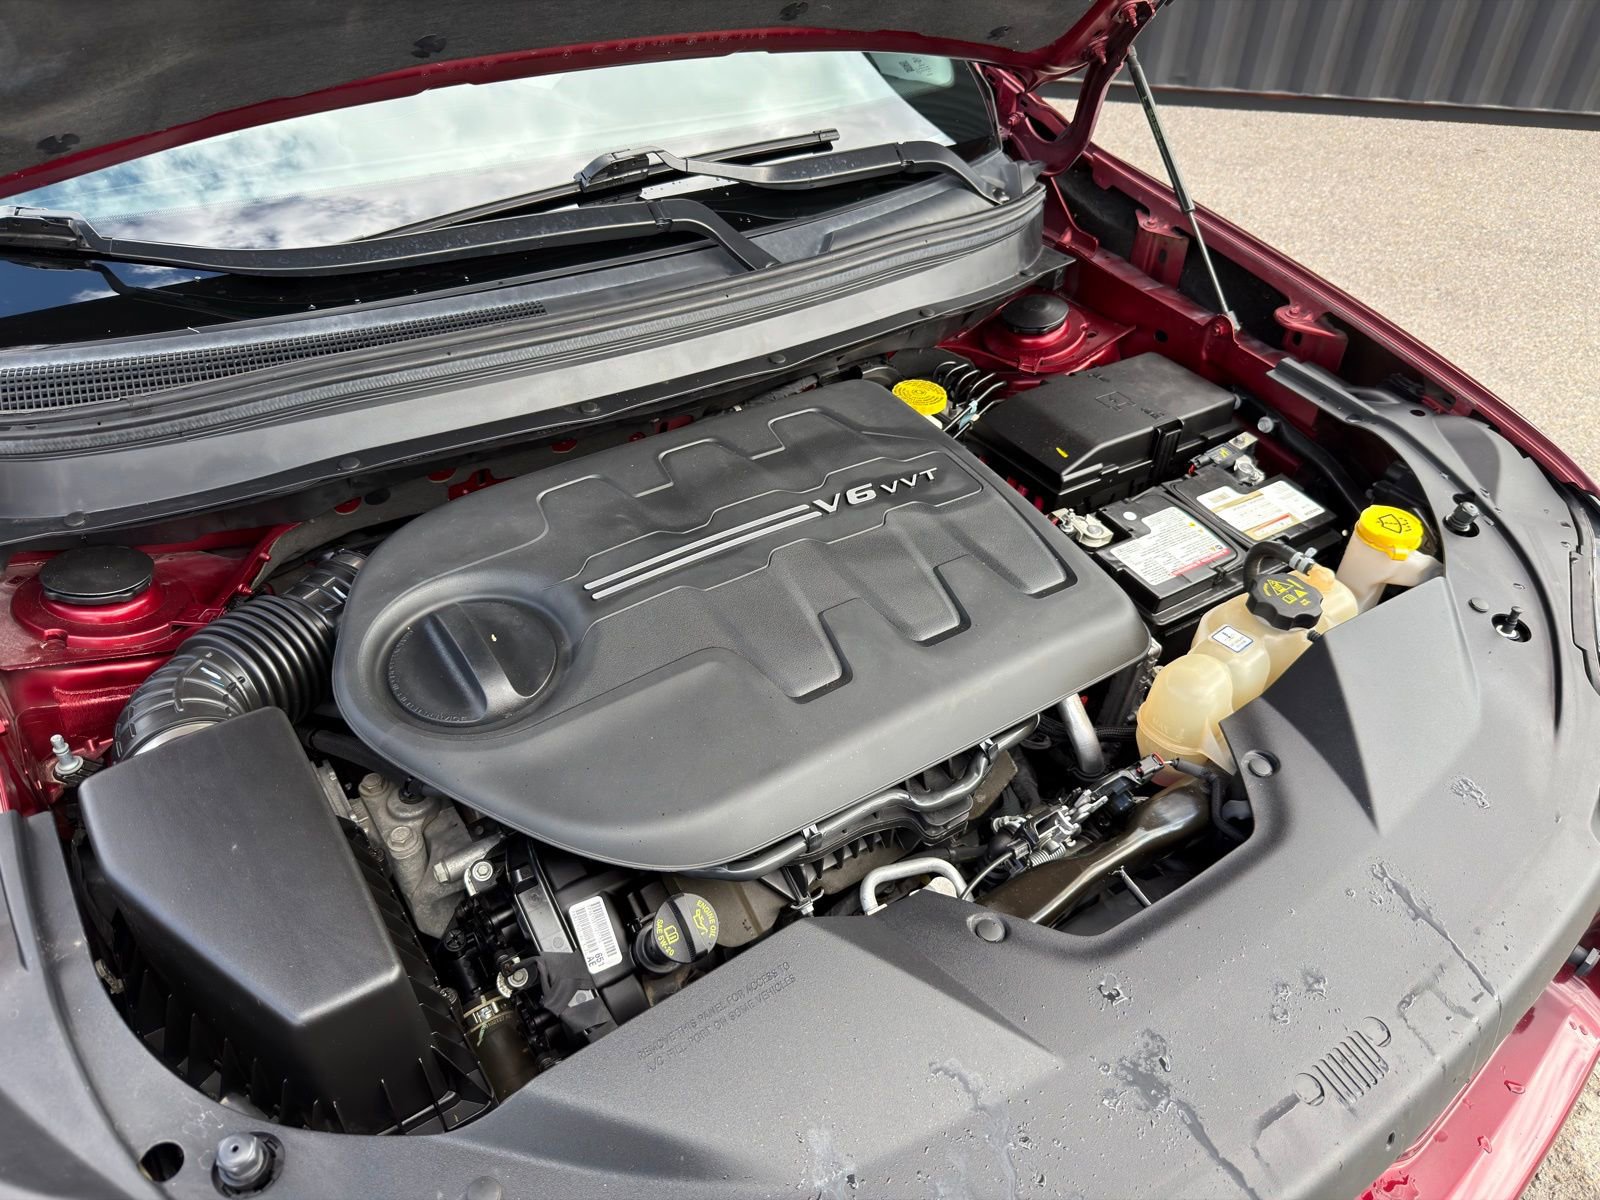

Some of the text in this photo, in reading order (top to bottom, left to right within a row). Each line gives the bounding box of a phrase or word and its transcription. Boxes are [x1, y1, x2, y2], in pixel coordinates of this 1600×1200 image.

[812, 467, 938, 513] V6 VVT
[656, 919, 675, 956] SAE 5W-20
[696, 899, 717, 938] ENGINE OIL
[638, 961, 790, 1060] REMOVE THIS PANEL FOR ACCESS TO
[667, 1043, 687, 1060] FILL
[687, 1026, 711, 1049] PORT
[713, 1015, 728, 1030] ON
[728, 1000, 755, 1021] SOME
[754, 974, 796, 1004] VEHICLES
